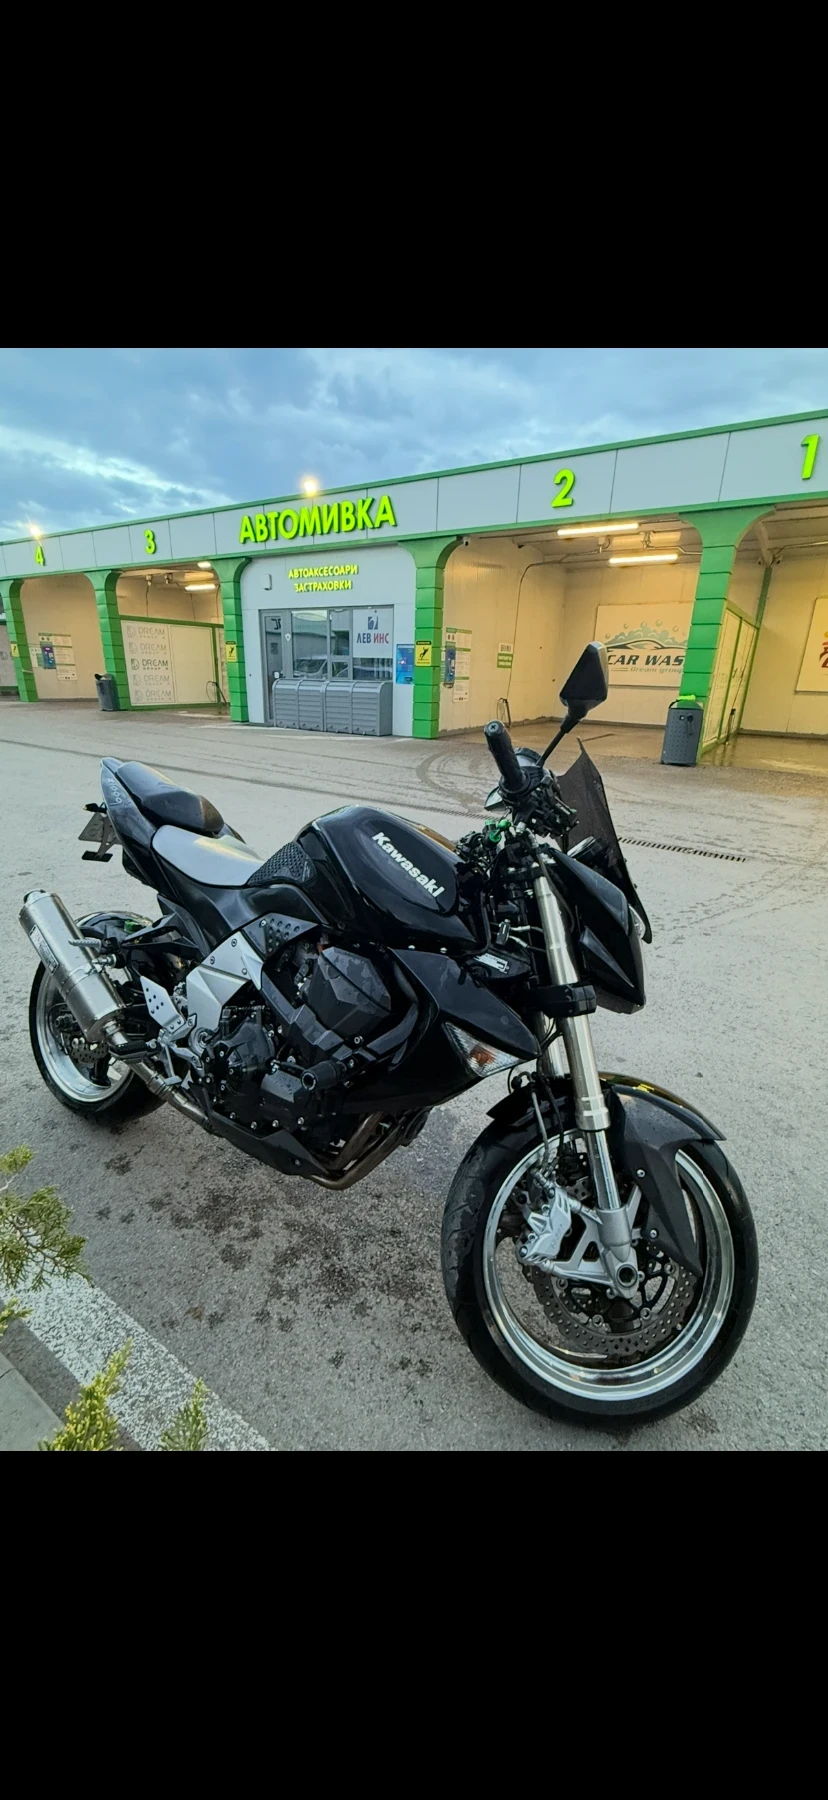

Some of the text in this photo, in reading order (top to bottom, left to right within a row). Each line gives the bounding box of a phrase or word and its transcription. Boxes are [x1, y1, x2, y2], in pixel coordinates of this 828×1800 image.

[801, 434, 820, 480] 1
[552, 468, 576, 508] 2
[239, 494, 397, 544] АВТОМИВКА
[144, 529, 157, 554] 3
[35, 545, 46, 566] 4
[288, 564, 359, 579] АВТОАКСЕСОАРИ
[294, 579, 352, 593] ЗАСТРАХОВКИ
[356, 632, 390, 644] ЛЕВ ИНС
[141, 658, 169, 667] DREAM
[608, 654, 685, 666] CAR WAS
[372, 832, 445, 897] Kawasaki
